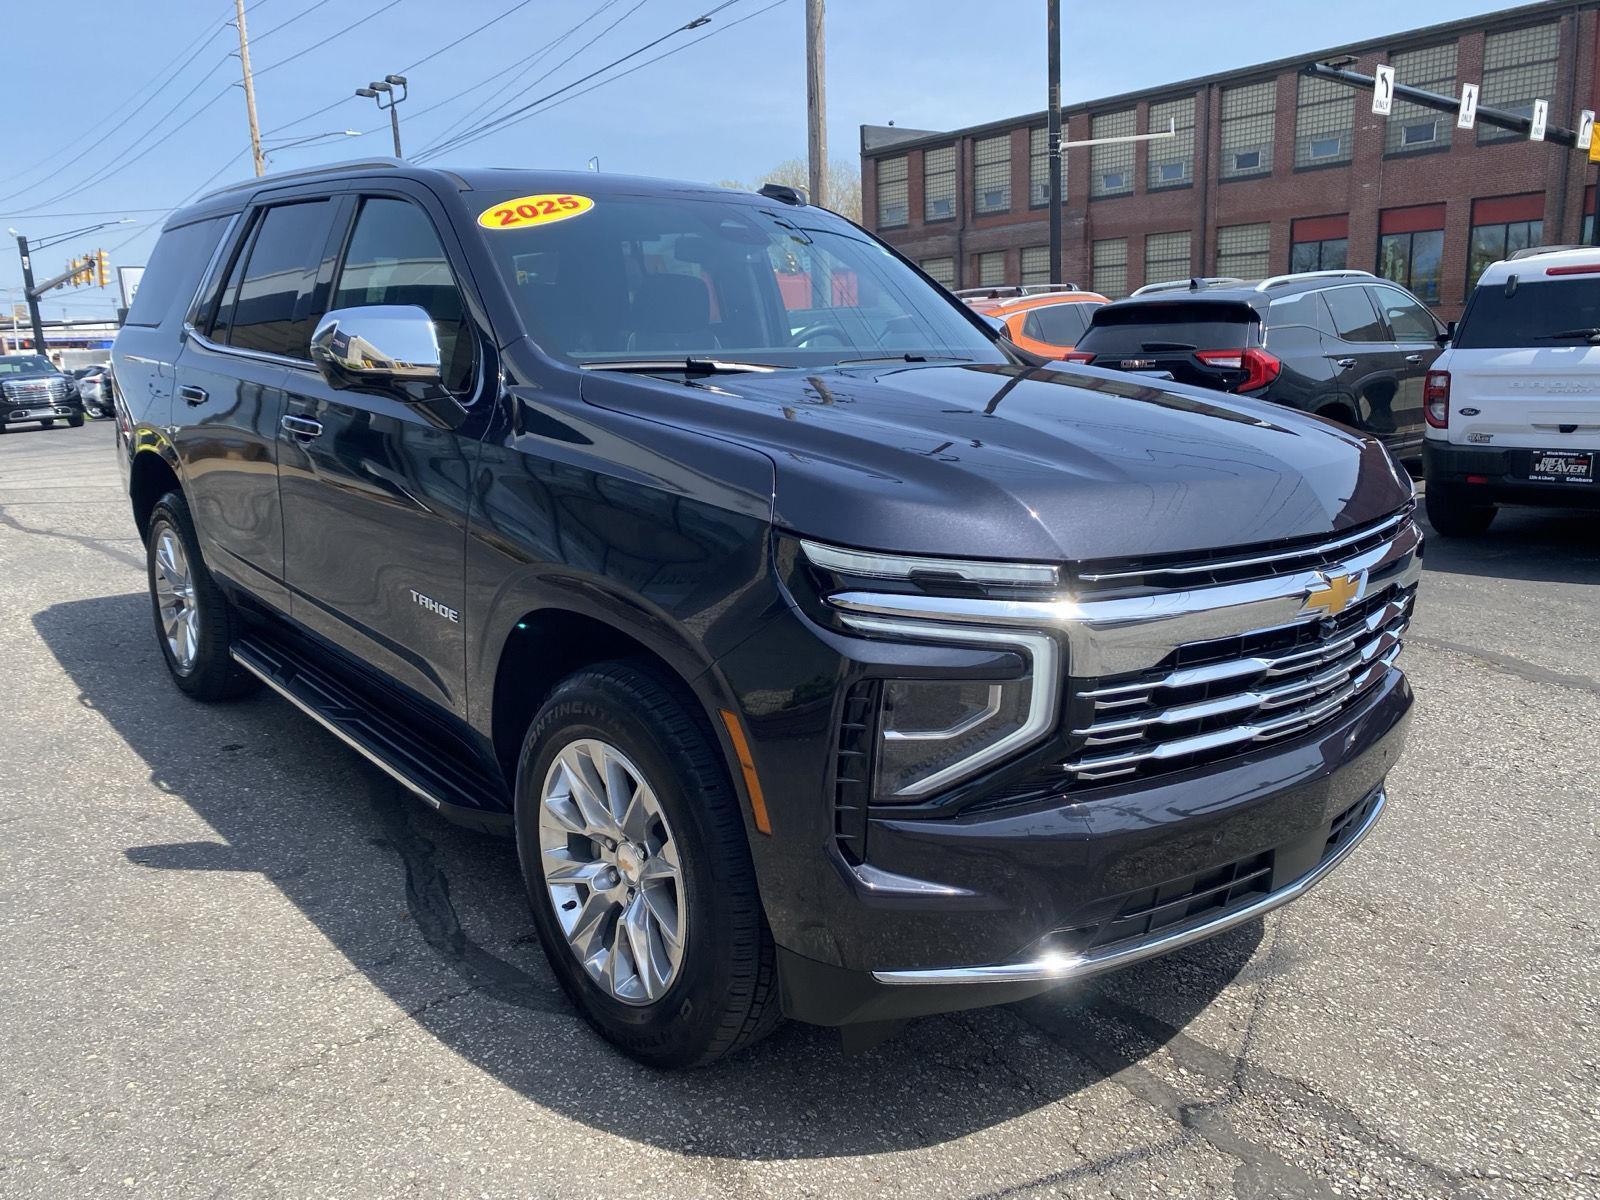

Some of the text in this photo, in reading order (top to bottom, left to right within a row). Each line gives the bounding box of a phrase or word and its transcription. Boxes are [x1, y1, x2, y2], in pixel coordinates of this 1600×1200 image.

[1375, 99, 1389, 110] ONLY
[1461, 113, 1472, 123] ONLY
[494, 196, 580, 226] 2025
[1120, 359, 1156, 369] GMC
[1541, 457, 1566, 466] RICK
[1535, 463, 1588, 473] WEAVER
[410, 589, 459, 623] TAHOE
